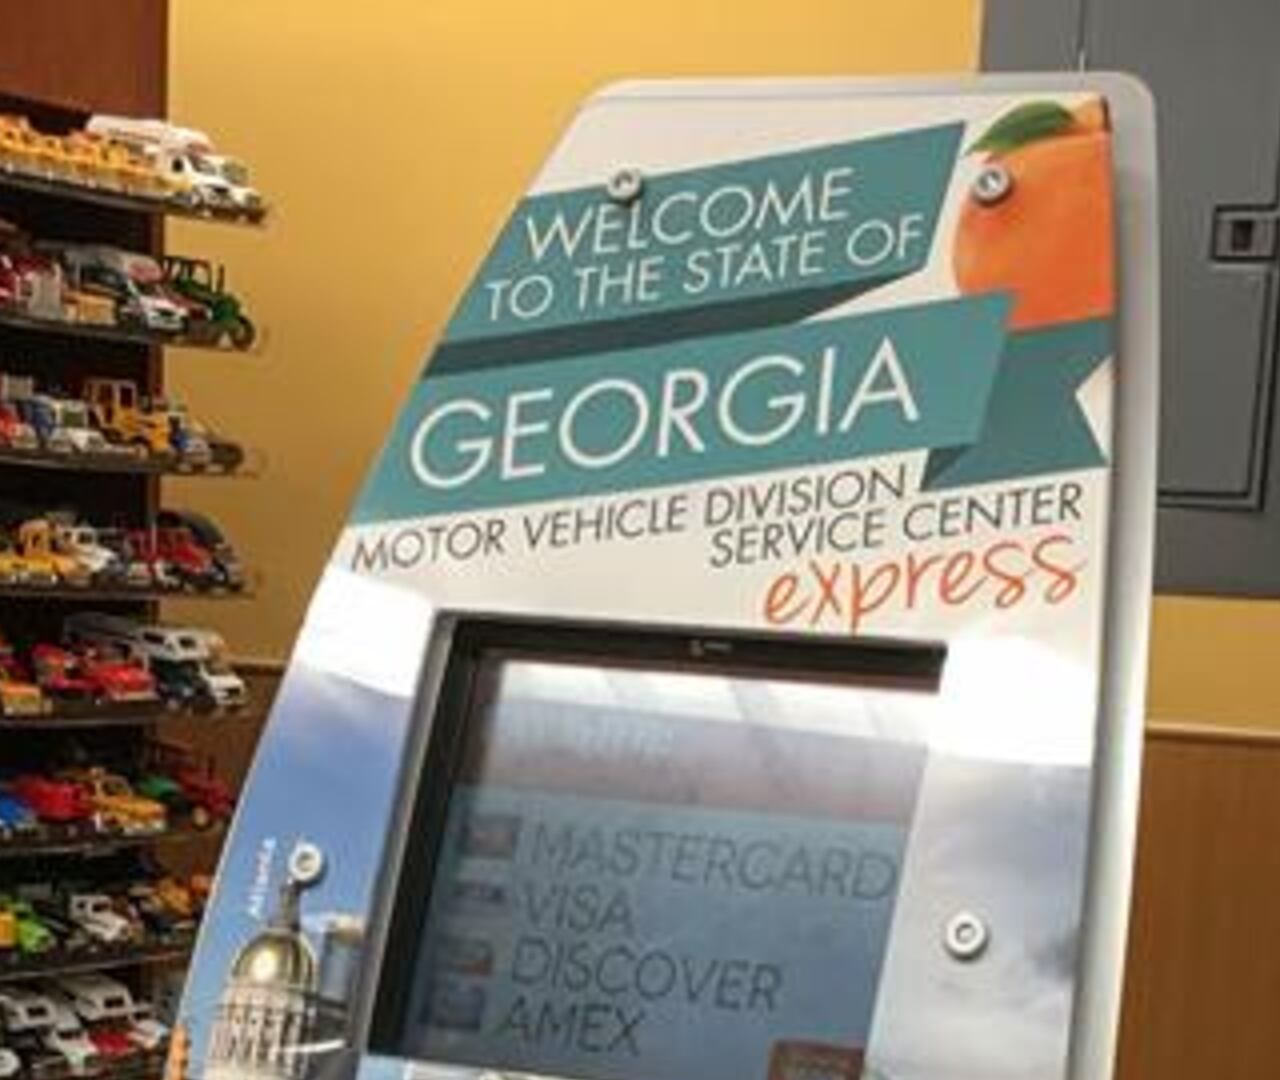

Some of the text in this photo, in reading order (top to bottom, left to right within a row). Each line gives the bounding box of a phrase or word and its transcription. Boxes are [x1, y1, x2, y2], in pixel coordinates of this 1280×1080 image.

[523, 166, 853, 264] WELCOME
[485, 211, 923, 322] TO THE STATE OF
[408, 335, 920, 490] GEORGIA
[349, 464, 906, 574] MOTOR VEHICLE DIVISION
[709, 482, 1084, 569] SERVICE CENTER
[764, 534, 1088, 632] express
[527, 822, 898, 900] MASTERCARD
[523, 883, 634, 935] VISA
[510, 937, 784, 1012] DISCOVER
[484, 994, 645, 1057] AMEX
